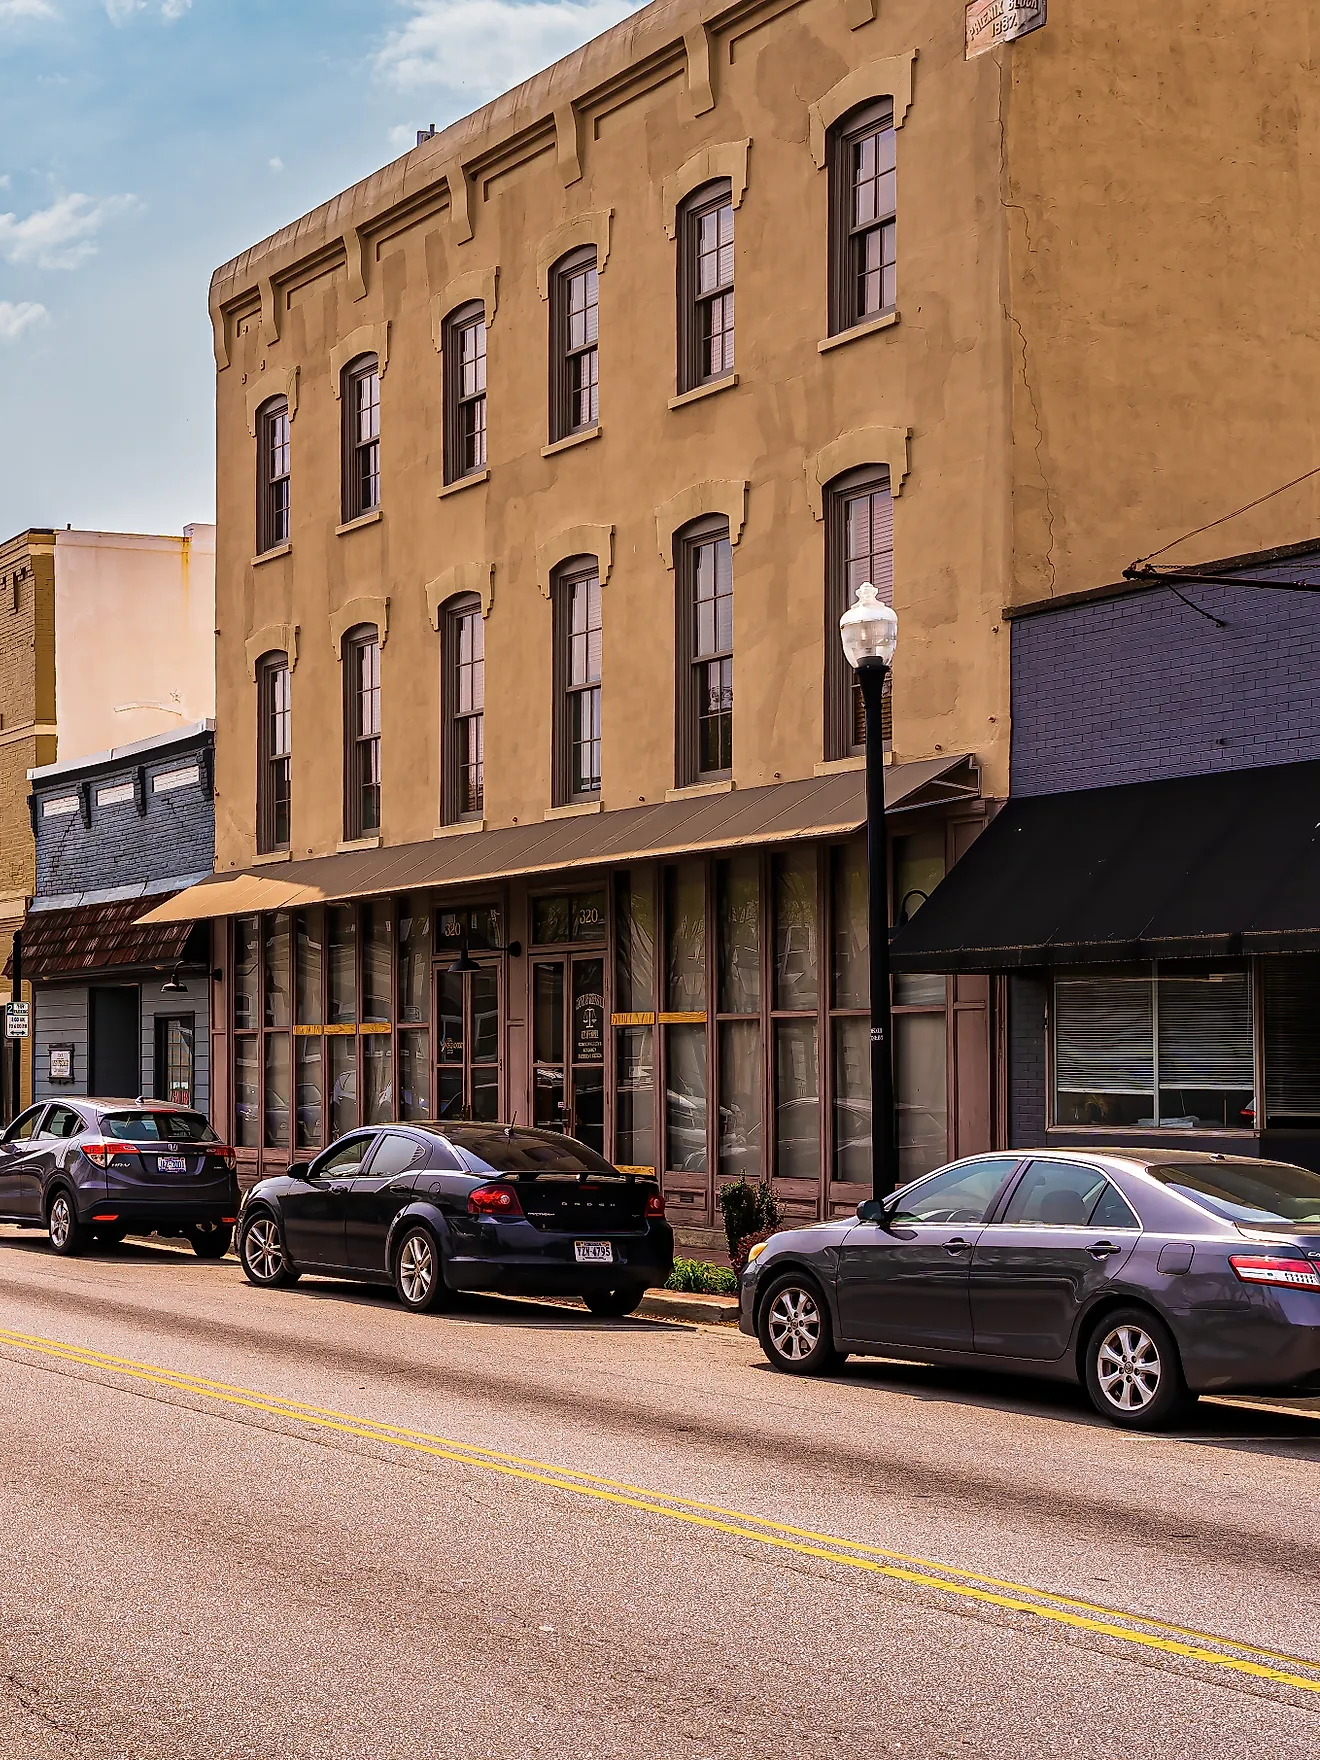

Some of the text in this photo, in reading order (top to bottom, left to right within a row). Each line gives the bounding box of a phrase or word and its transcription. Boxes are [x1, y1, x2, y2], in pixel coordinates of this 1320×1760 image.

[580, 908, 598, 924] 320
[445, 922, 460, 937] 320
[7, 1004, 14, 1014] 2
